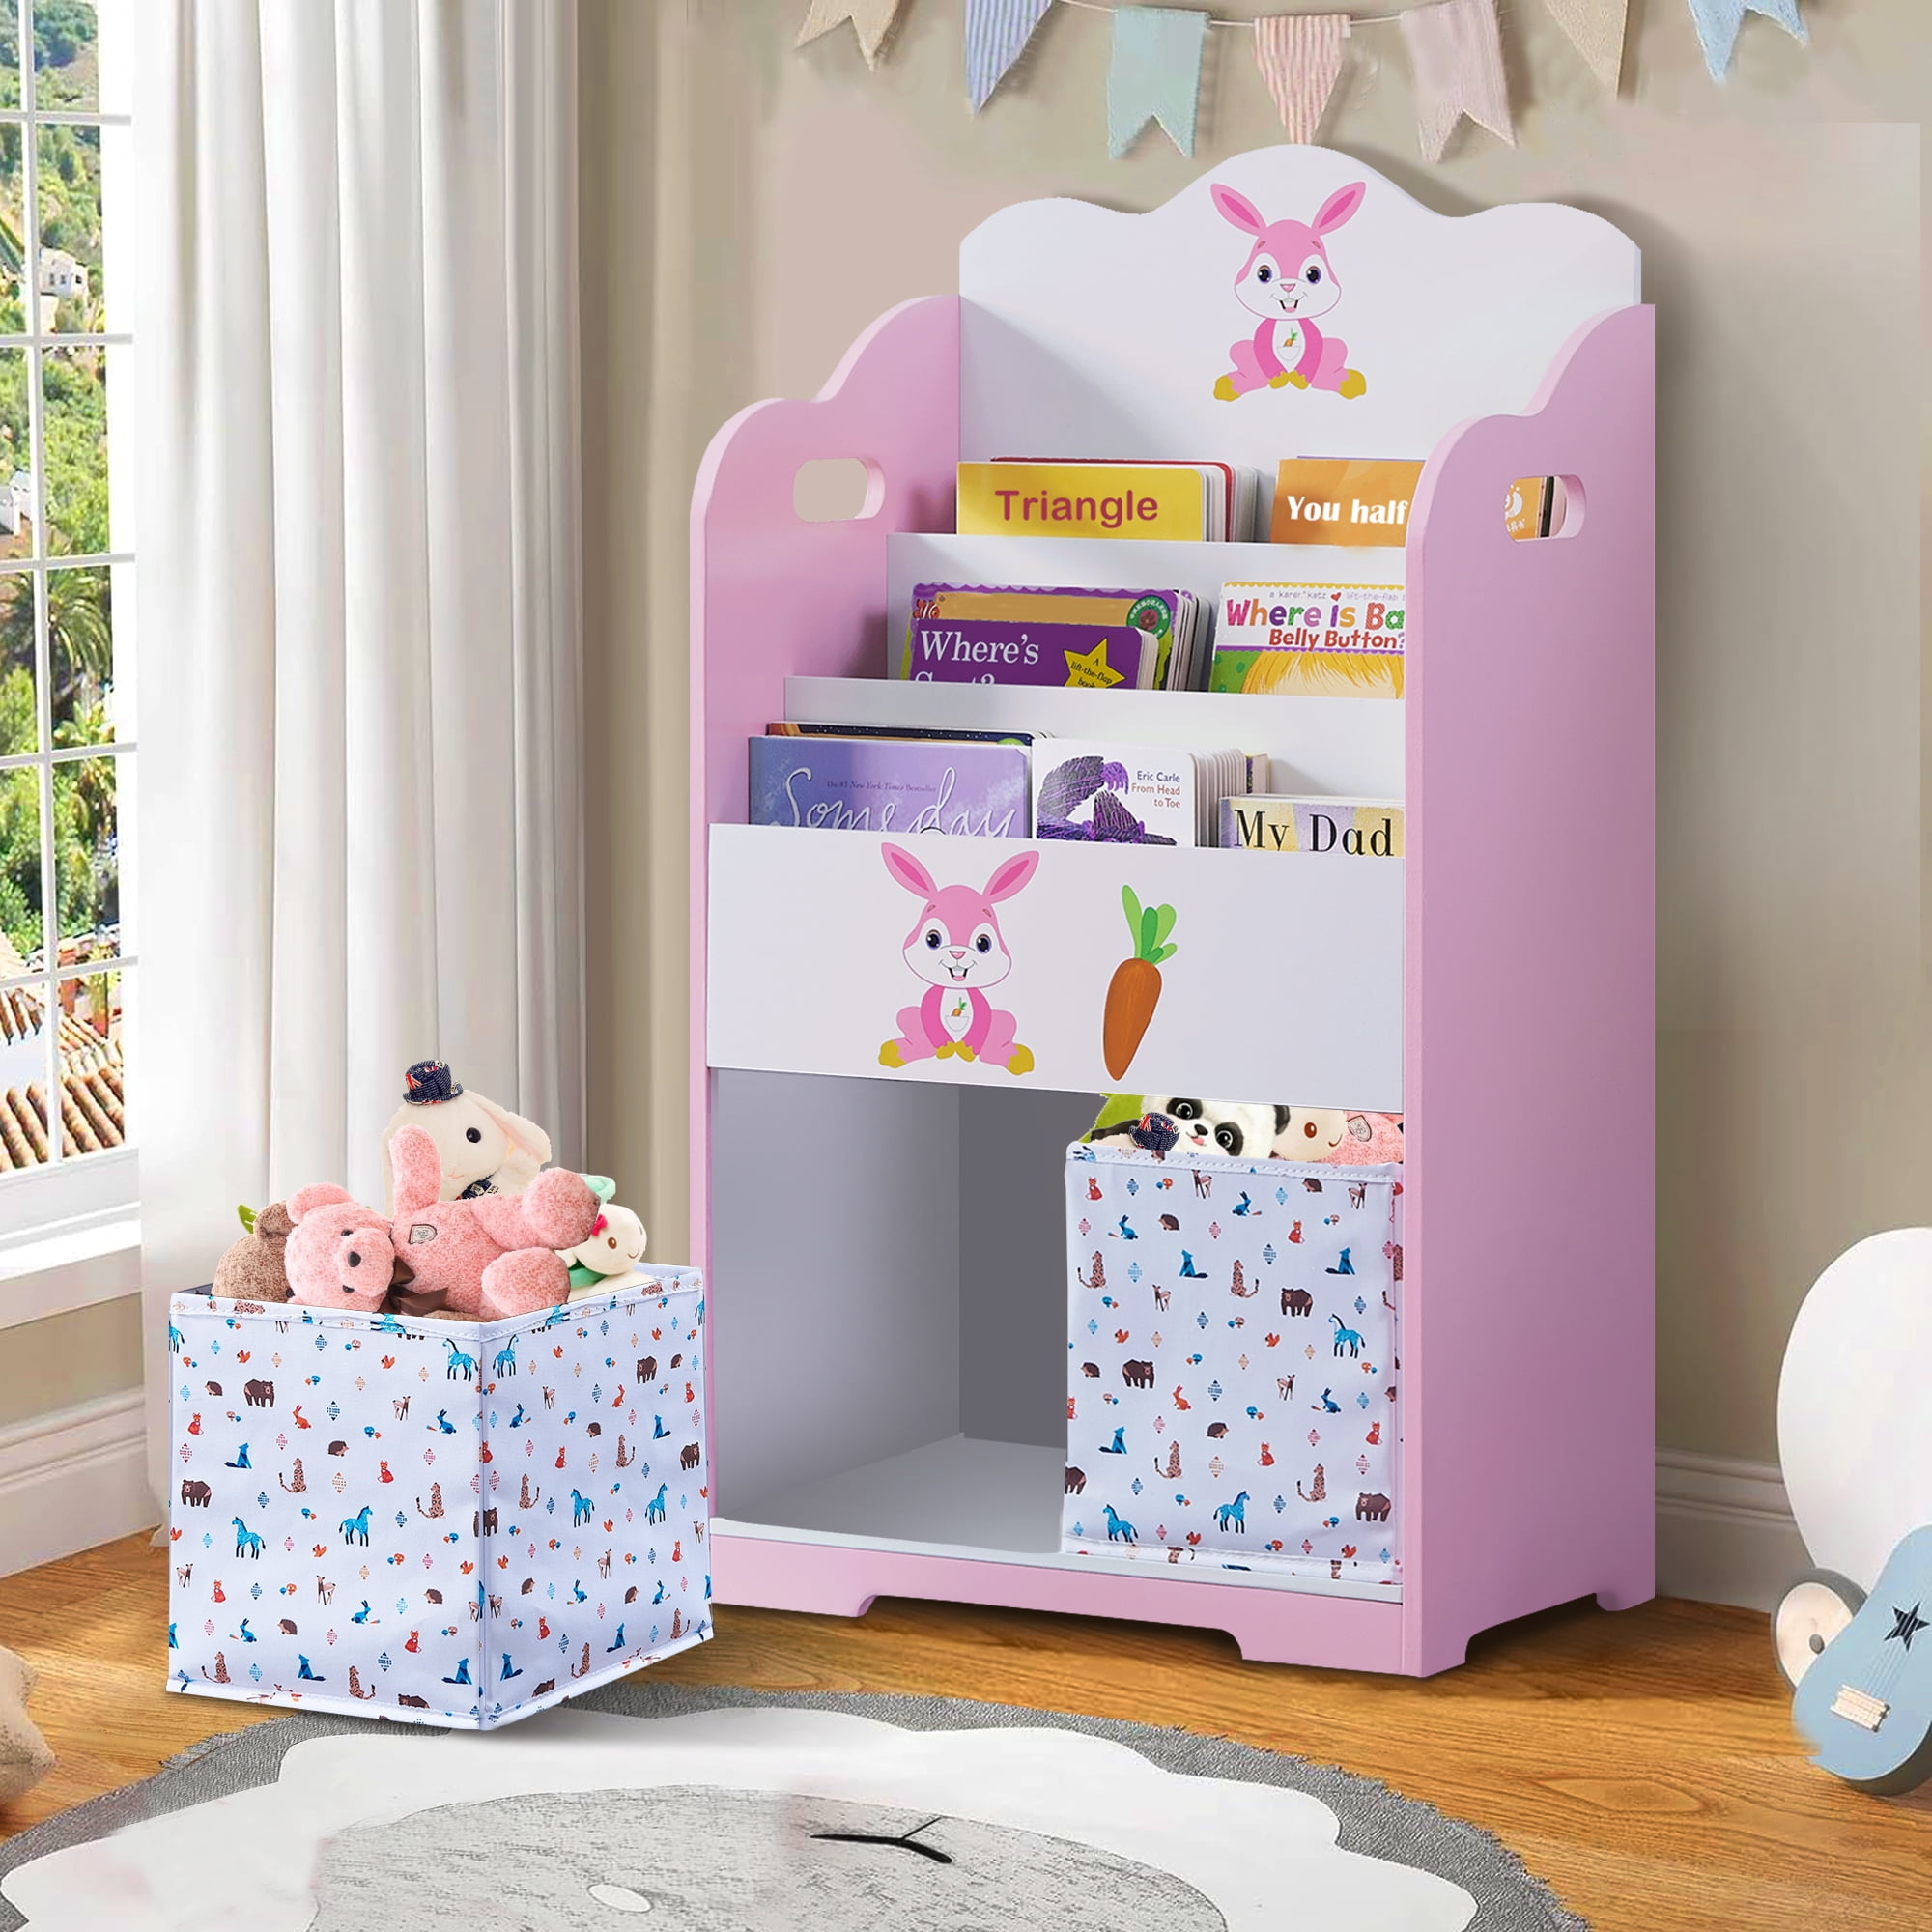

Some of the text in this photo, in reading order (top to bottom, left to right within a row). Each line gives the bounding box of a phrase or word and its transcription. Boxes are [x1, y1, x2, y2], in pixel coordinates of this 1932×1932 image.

[994, 490, 1158, 528] Triangle
[1287, 496, 1408, 525] You half
[1226, 599, 1321, 627] Where
[1329, 604, 1356, 628] is
[921, 630, 1039, 665] Where's
[1268, 627, 1320, 652] Belly
[850, 781, 865, 789] New
[866, 781, 882, 790] York
[884, 782, 904, 791] Times
[1131, 782, 1180, 796] From Head
[1137, 770, 1180, 783] Eric Carle
[1154, 798, 1180, 809] to Toe
[1234, 809, 1394, 856] My Dad
